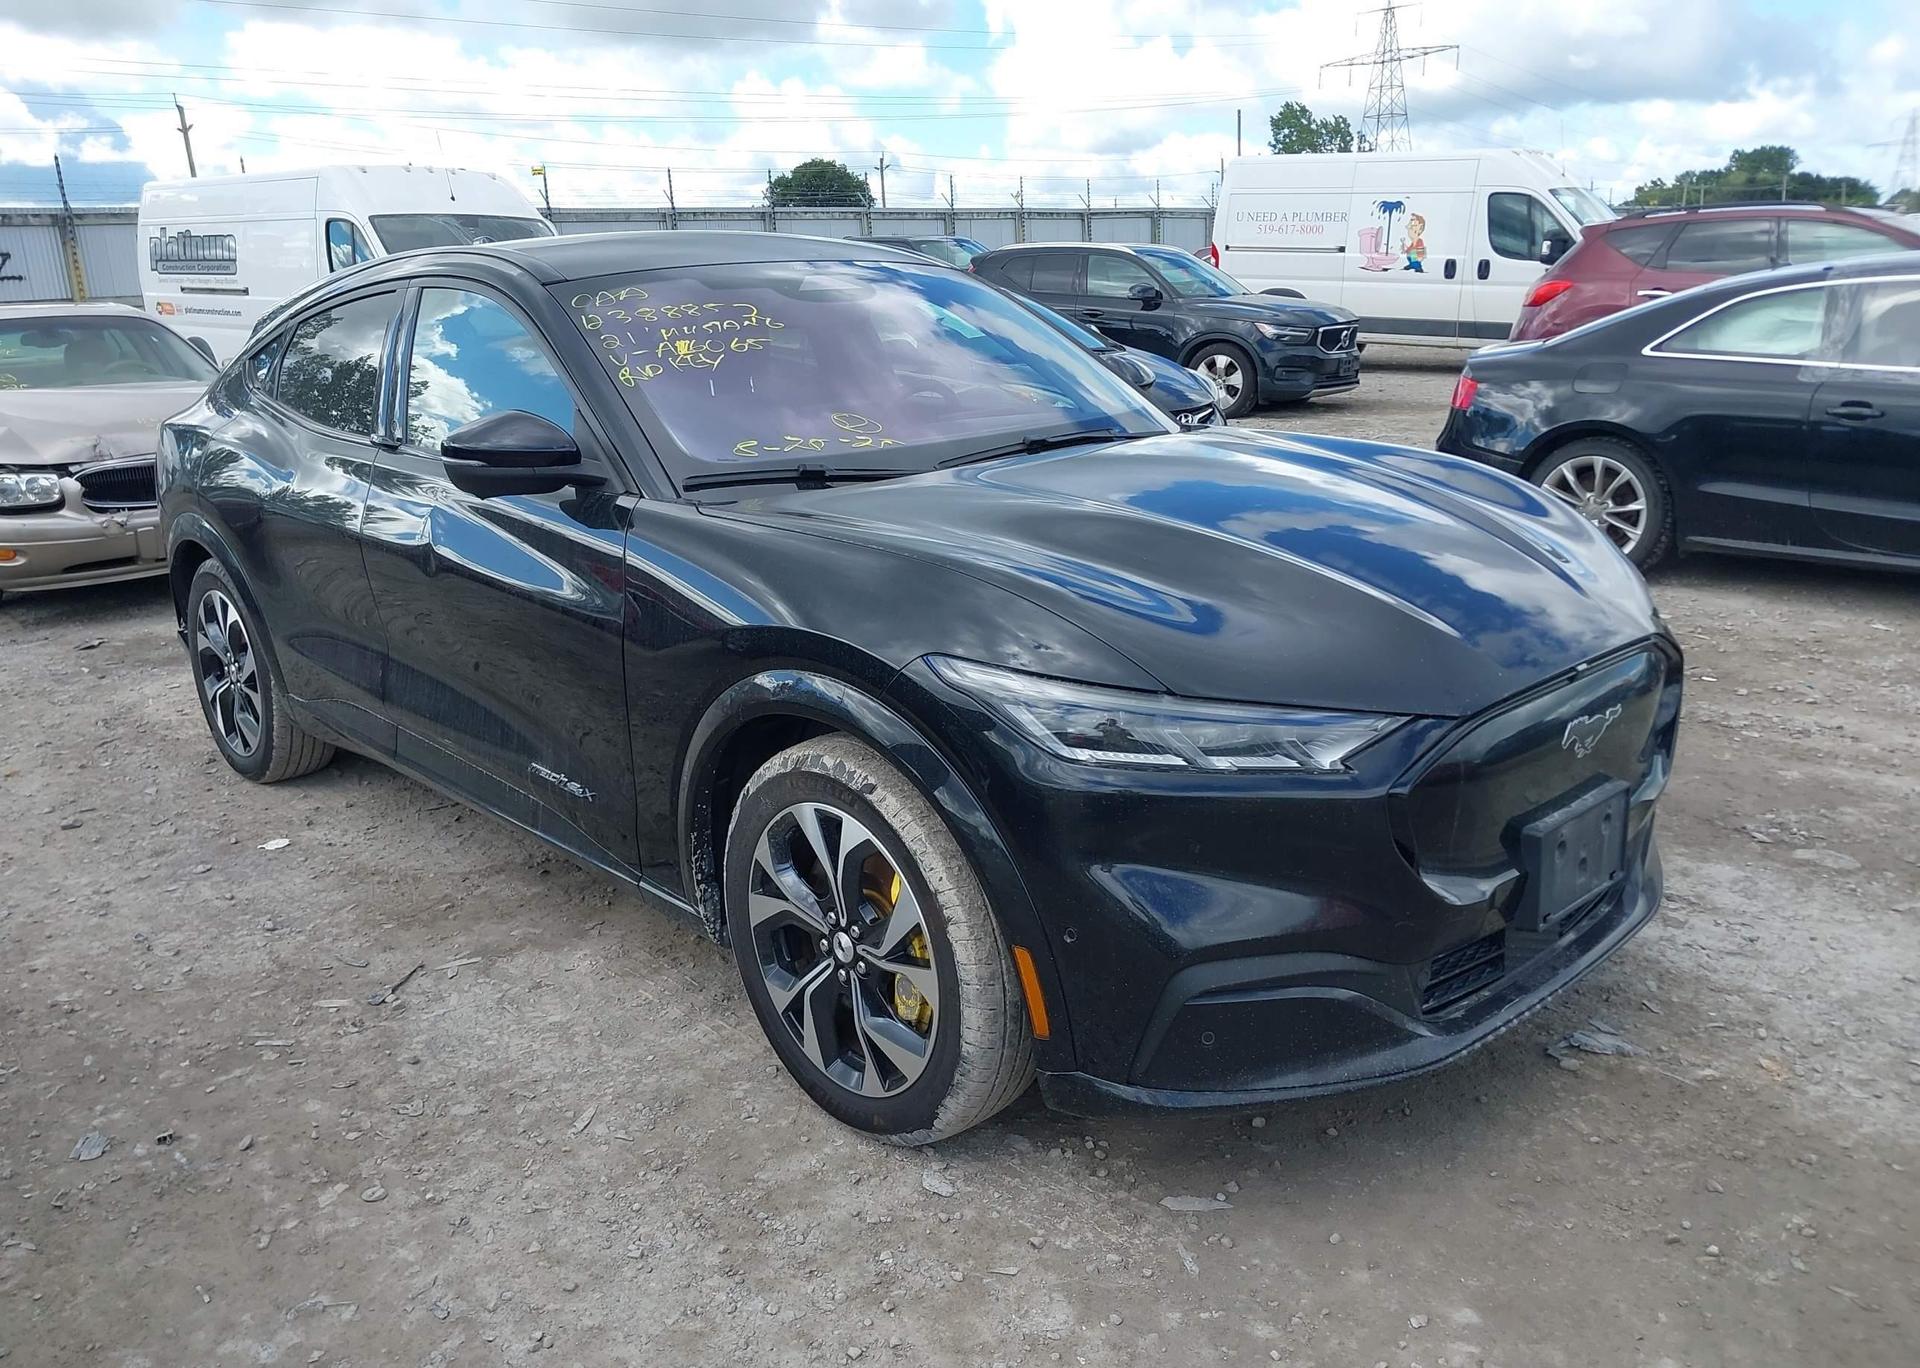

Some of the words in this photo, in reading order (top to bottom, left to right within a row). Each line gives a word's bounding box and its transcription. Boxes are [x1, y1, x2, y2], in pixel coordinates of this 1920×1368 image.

[1236, 211, 1245, 222] U
[1247, 211, 1278, 222] NEED
[1280, 211, 1289, 222] A
[1291, 211, 1349, 223] PLUMBER
[1257, 224, 1324, 235] 519-617-8000
[149, 227, 237, 271] platinum
[161, 263, 196, 272] Construction
[197, 263, 231, 272] Corporation
